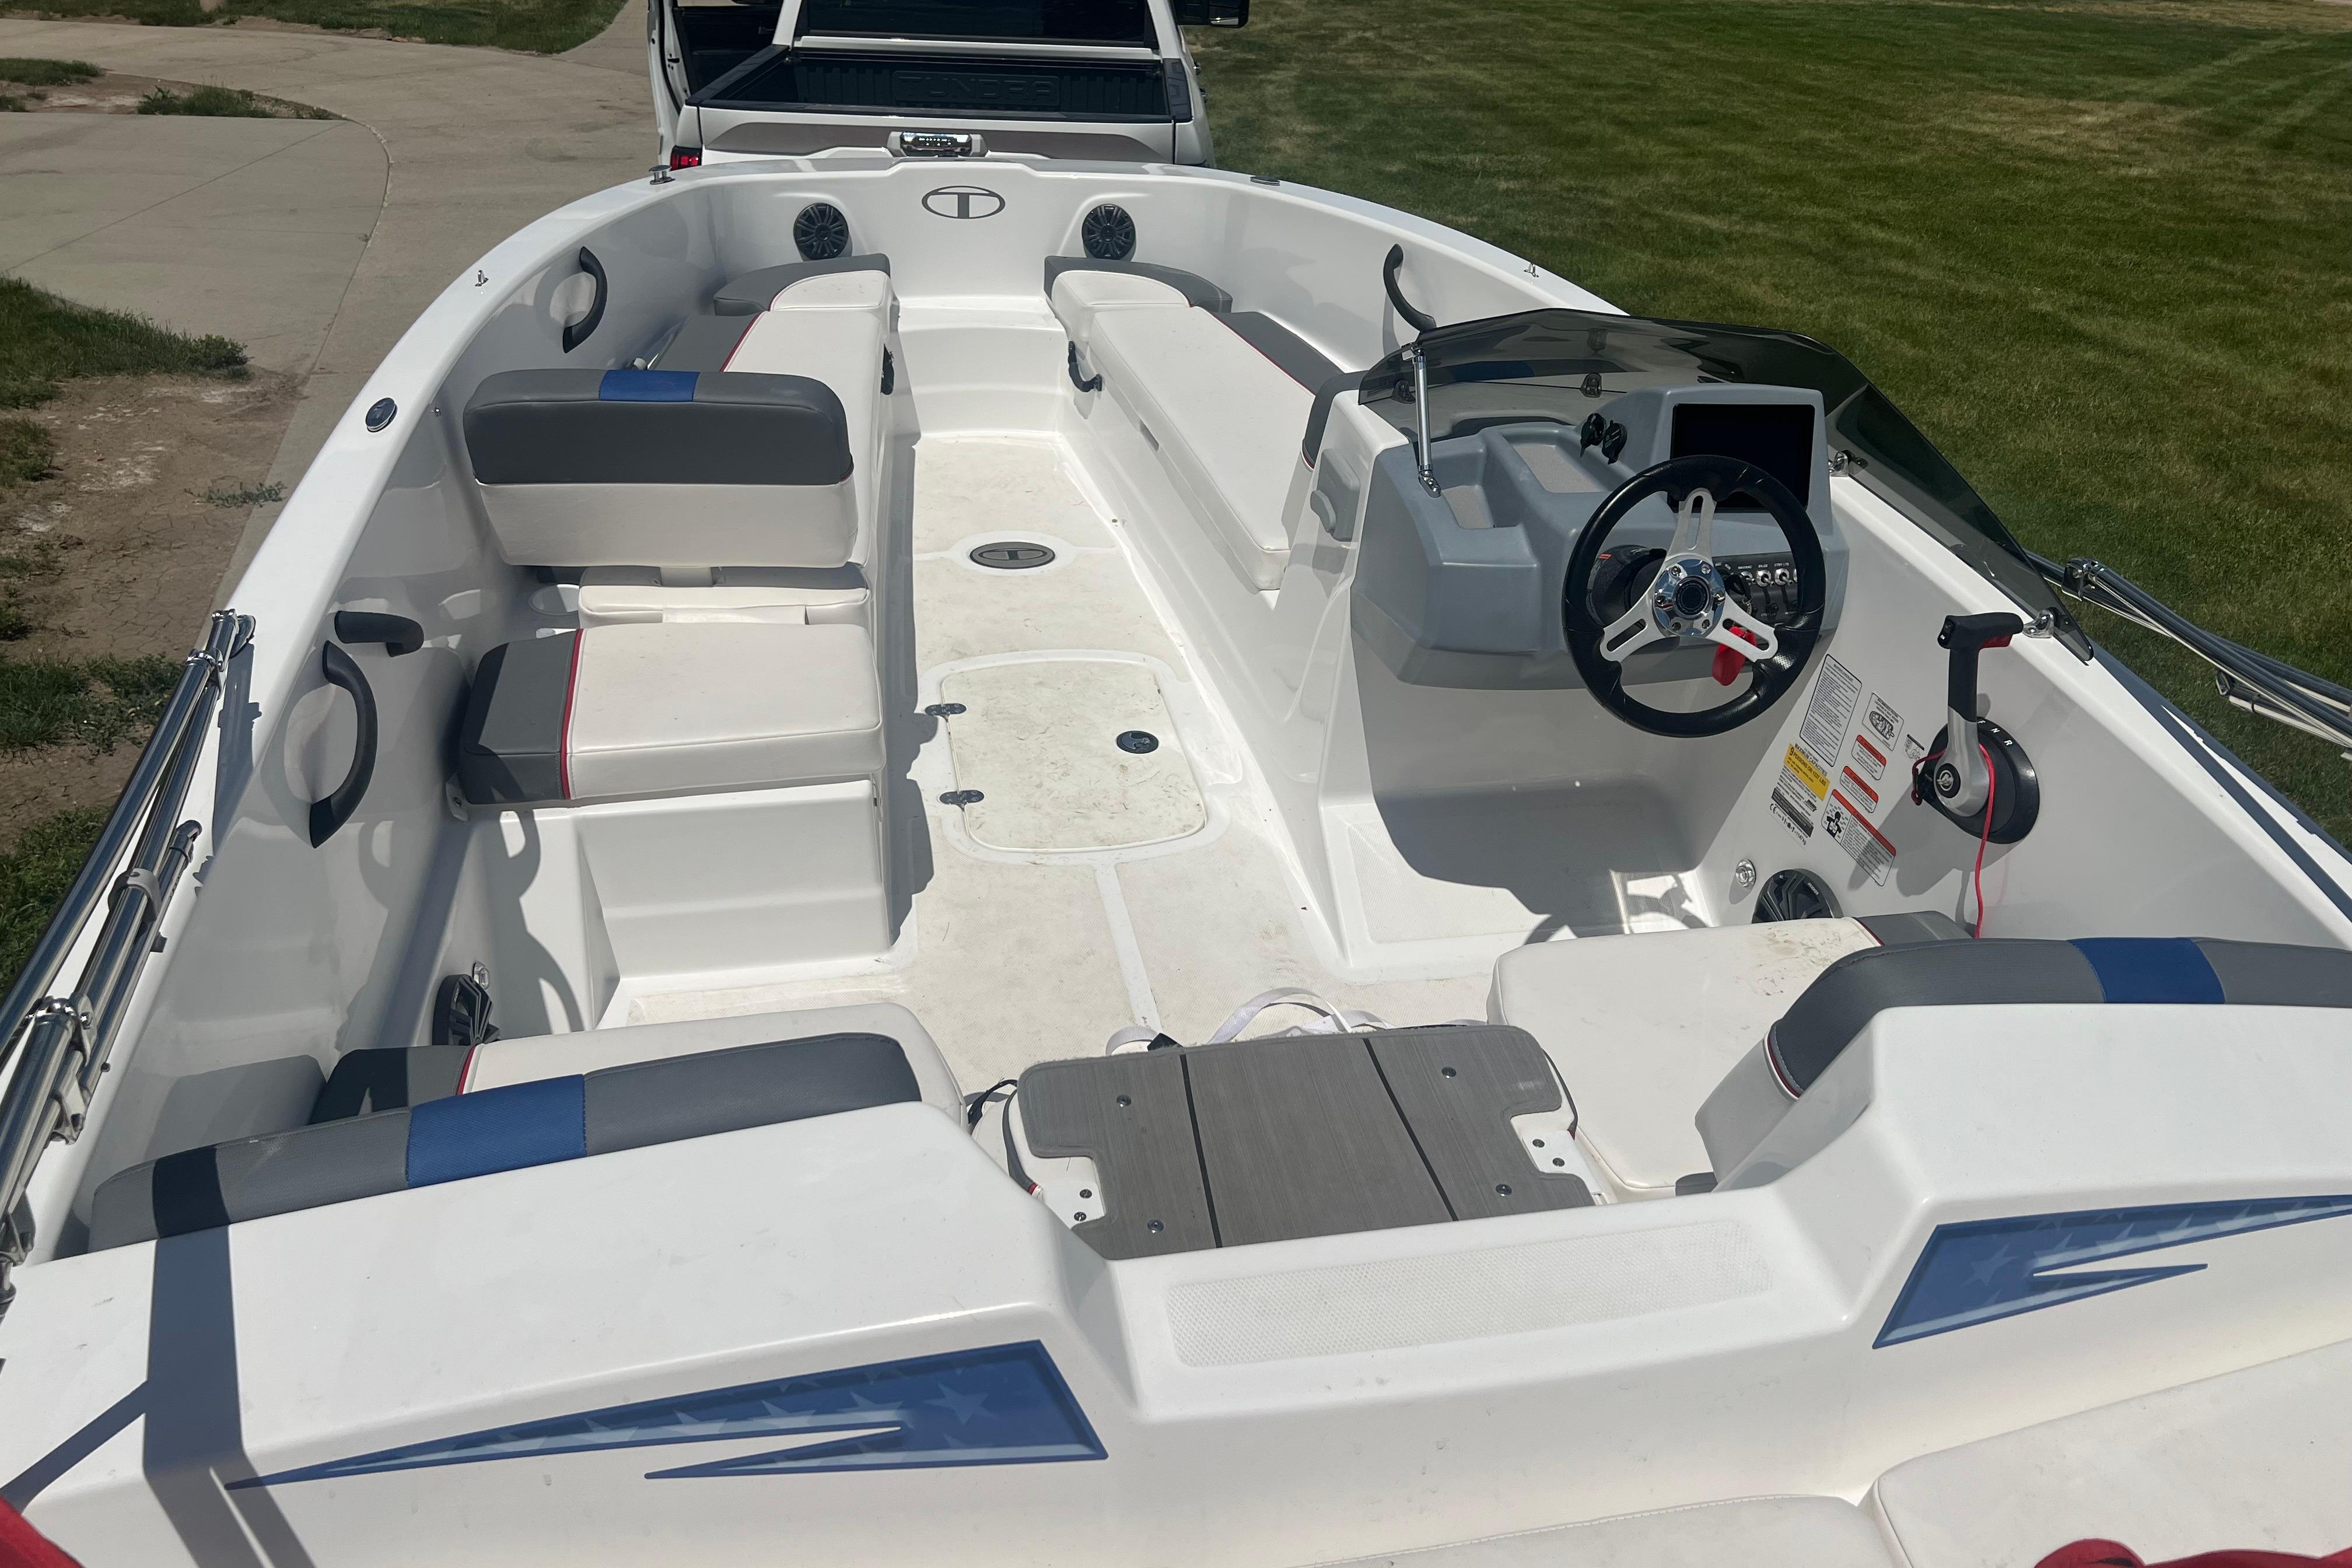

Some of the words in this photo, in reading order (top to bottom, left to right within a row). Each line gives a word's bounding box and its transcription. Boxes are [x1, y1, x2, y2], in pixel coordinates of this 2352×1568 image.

[898, 76, 1056, 102] TUNDRA
[1789, 747, 1794, 756] 9
[1793, 752, 1808, 768] PERSONS
[1809, 757, 1828, 777] CAPACITIES
